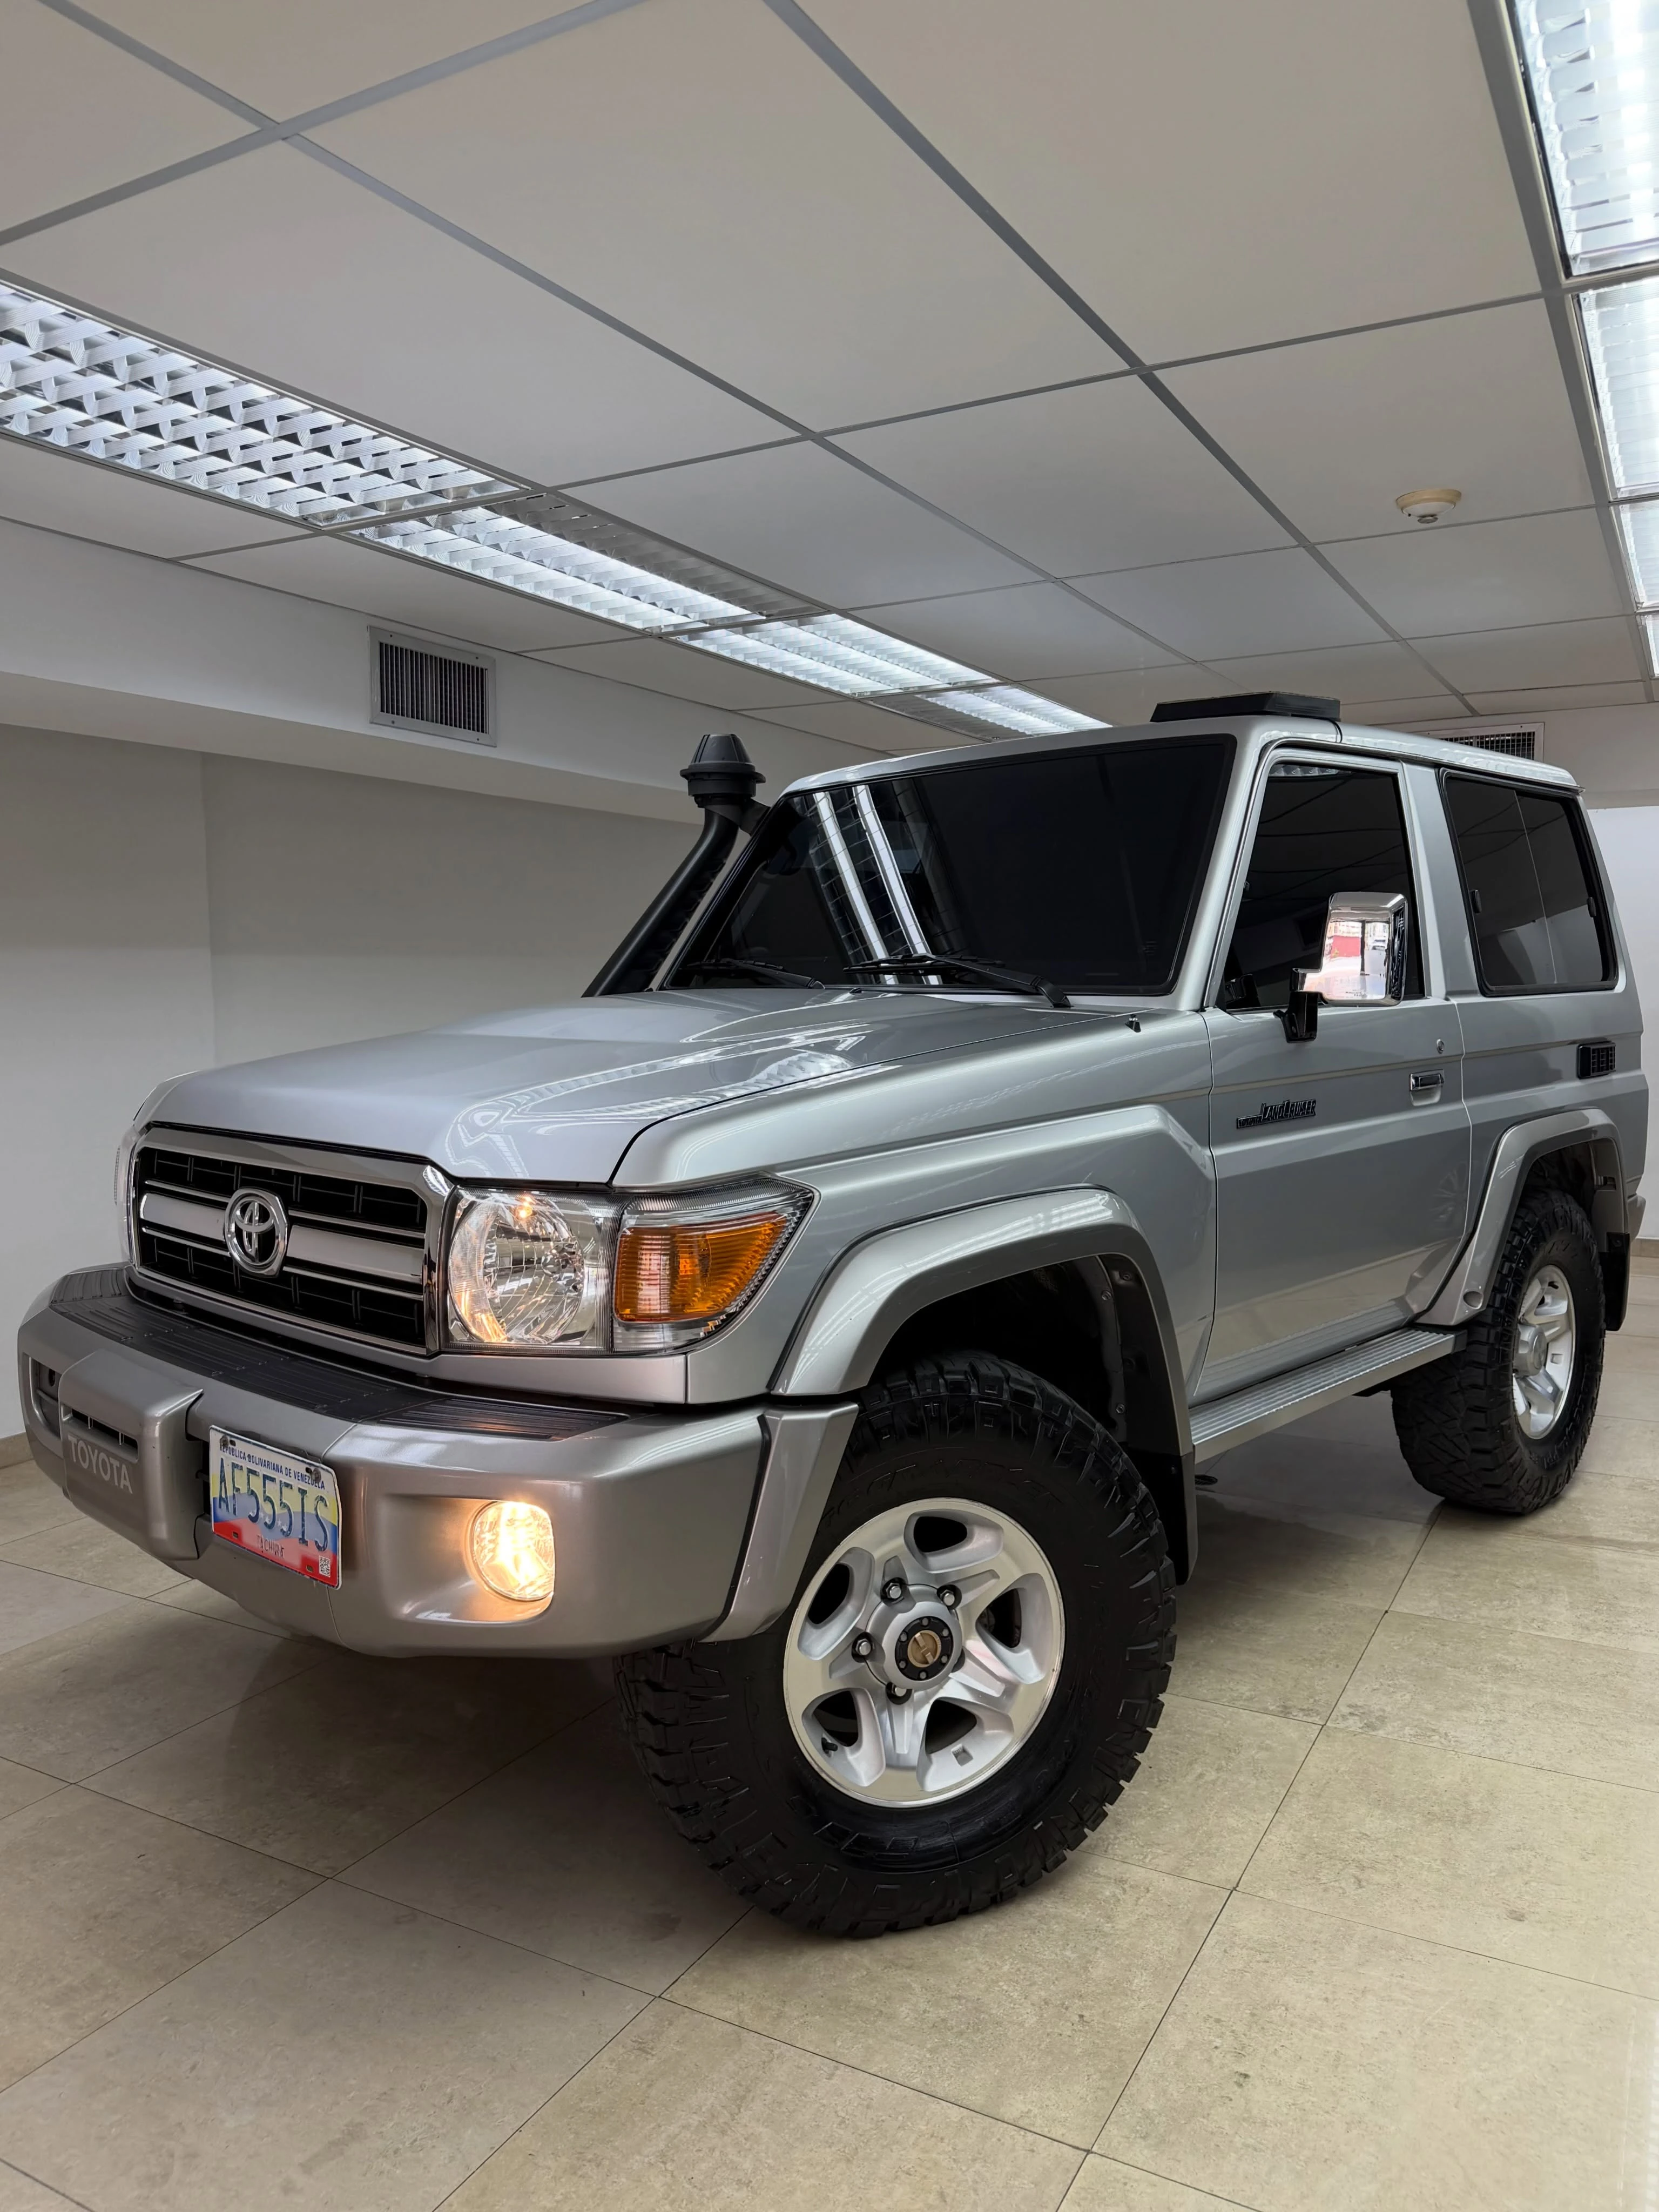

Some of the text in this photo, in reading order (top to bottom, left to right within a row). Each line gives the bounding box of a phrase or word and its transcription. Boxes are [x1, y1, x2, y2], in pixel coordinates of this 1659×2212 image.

[68, 1434, 133, 1495] TOYOTA
[247, 1454, 284, 1475] BOLIVARIANA
[285, 1467, 292, 1478] DE
[293, 1470, 325, 1490] VENEZUELA
[219, 1458, 328, 1552] AF555IS
